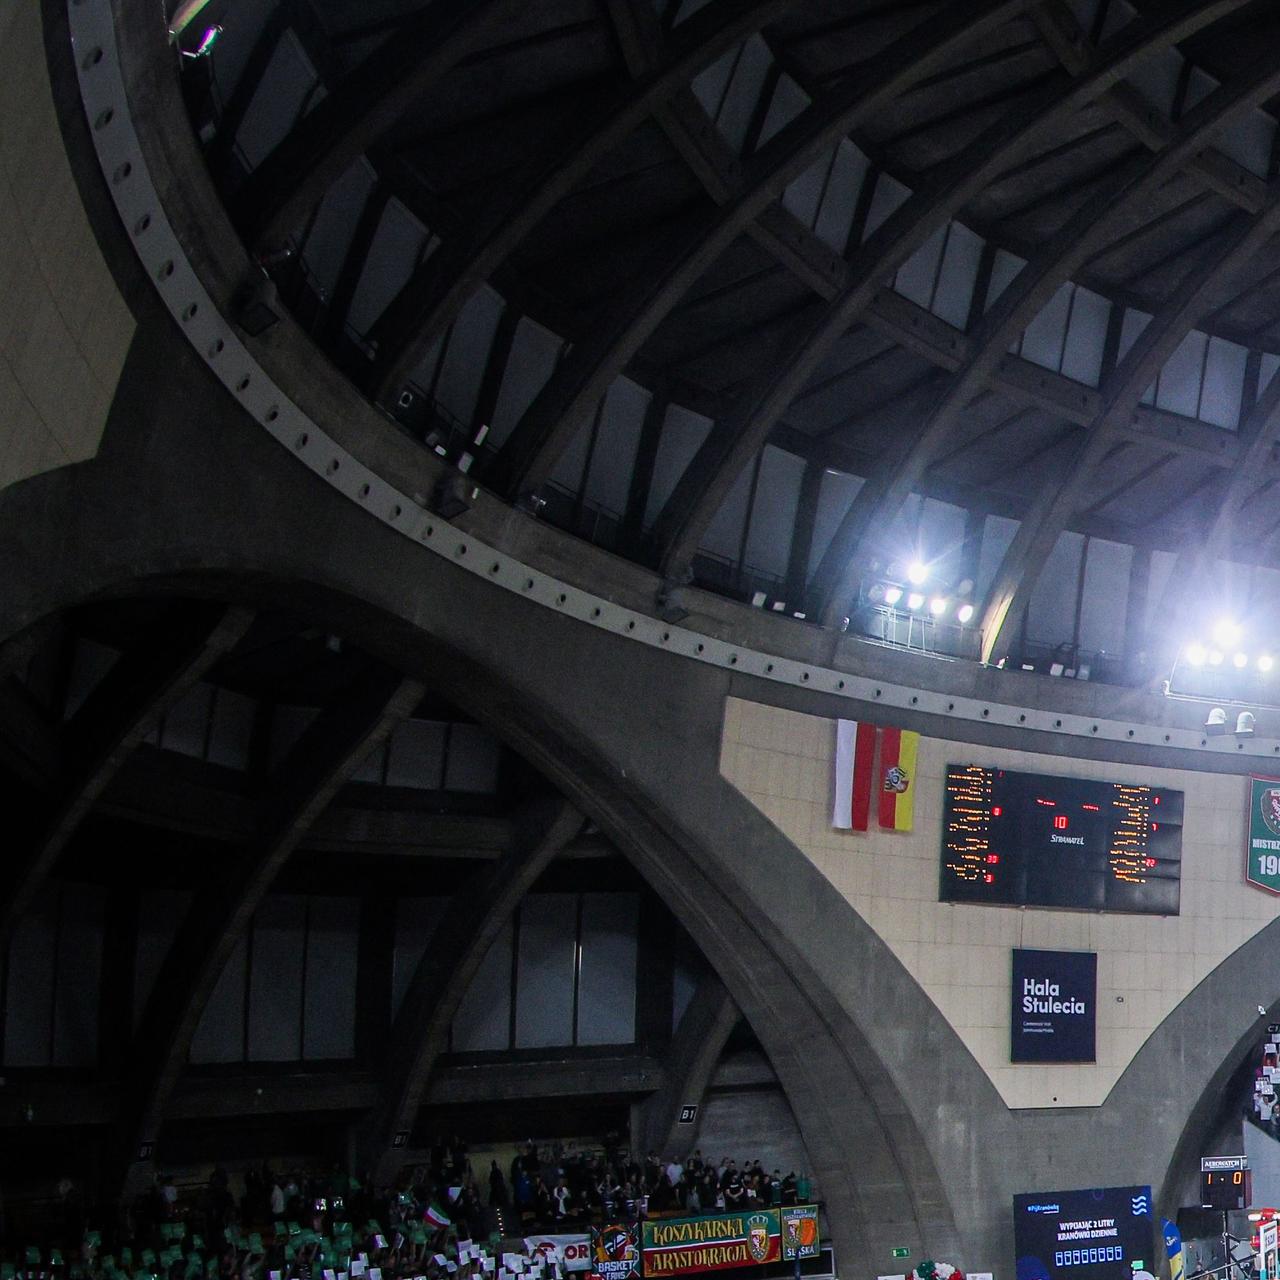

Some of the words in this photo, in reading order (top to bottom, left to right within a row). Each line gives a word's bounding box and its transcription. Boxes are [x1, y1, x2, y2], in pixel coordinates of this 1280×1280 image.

[1253, 839, 1280, 851] MISTRZ
[1023, 978, 1060, 997] Hala
[1022, 996, 1085, 1014] Stulecia
[682, 1110, 694, 1120] B1
[1233, 1171, 1242, 1185] 0
[1098, 1219, 1115, 1229] LITRY
[653, 1218, 744, 1244] KOSZYKARSKA
[1057, 1229, 1090, 1241] KRANÓWKI
[1091, 1228, 1118, 1239] DZIENNIE
[653, 1244, 747, 1270] ARYSTOKRACJA
[598, 1261, 634, 1274] BASKET
